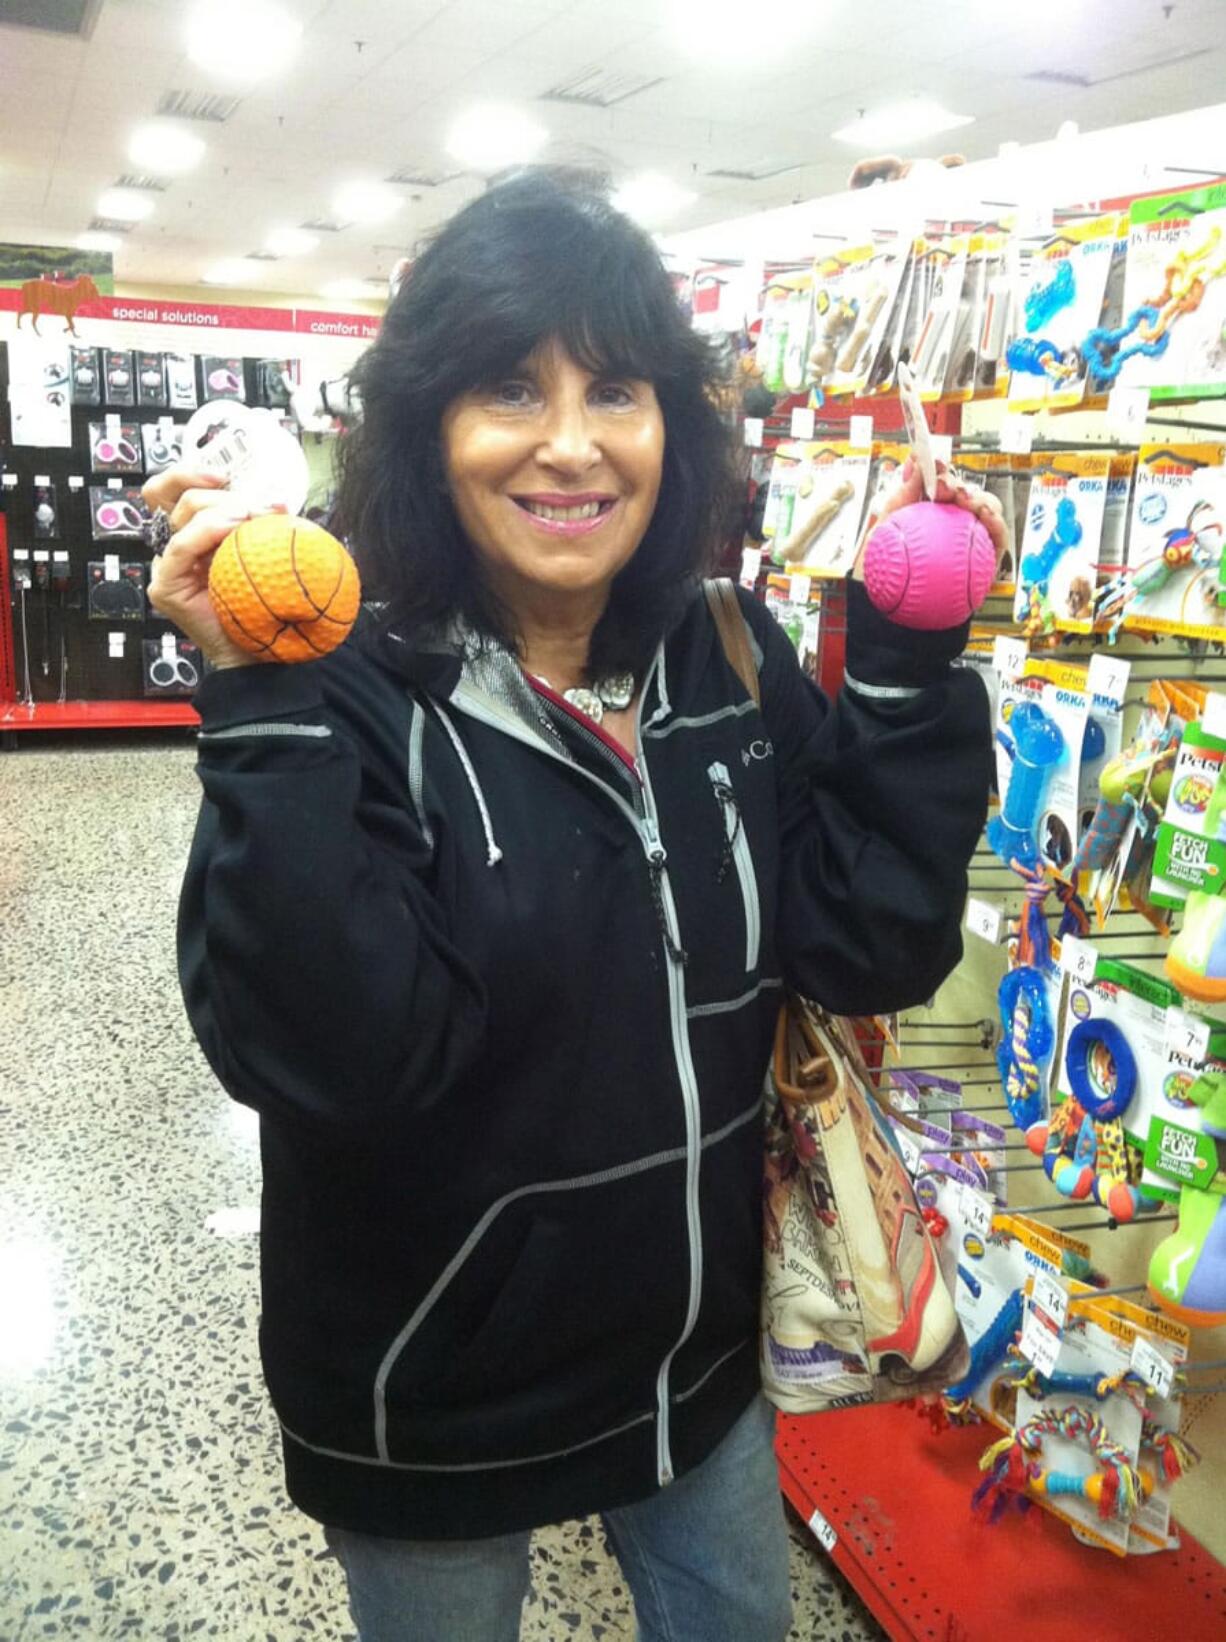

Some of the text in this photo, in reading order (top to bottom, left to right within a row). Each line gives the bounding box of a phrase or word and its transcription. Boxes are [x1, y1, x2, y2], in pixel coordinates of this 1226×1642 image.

[112, 307, 219, 325] special solutions
[311, 320, 358, 336] comfort
[1055, 690, 1086, 708] ORKA
[1173, 831, 1208, 852] FETCH
[1171, 841, 1207, 864] FUN
[927, 1125, 950, 1145] play
[1161, 1135, 1195, 1160] FUN
[956, 1168, 977, 1188] play
[974, 1207, 985, 1224] 14
[1029, 1235, 1061, 1260] chew
[1049, 1293, 1060, 1312] 14
[1110, 1320, 1135, 1338] che
[1145, 1314, 1187, 1339] chew
[1150, 1364, 1163, 1385] 11
